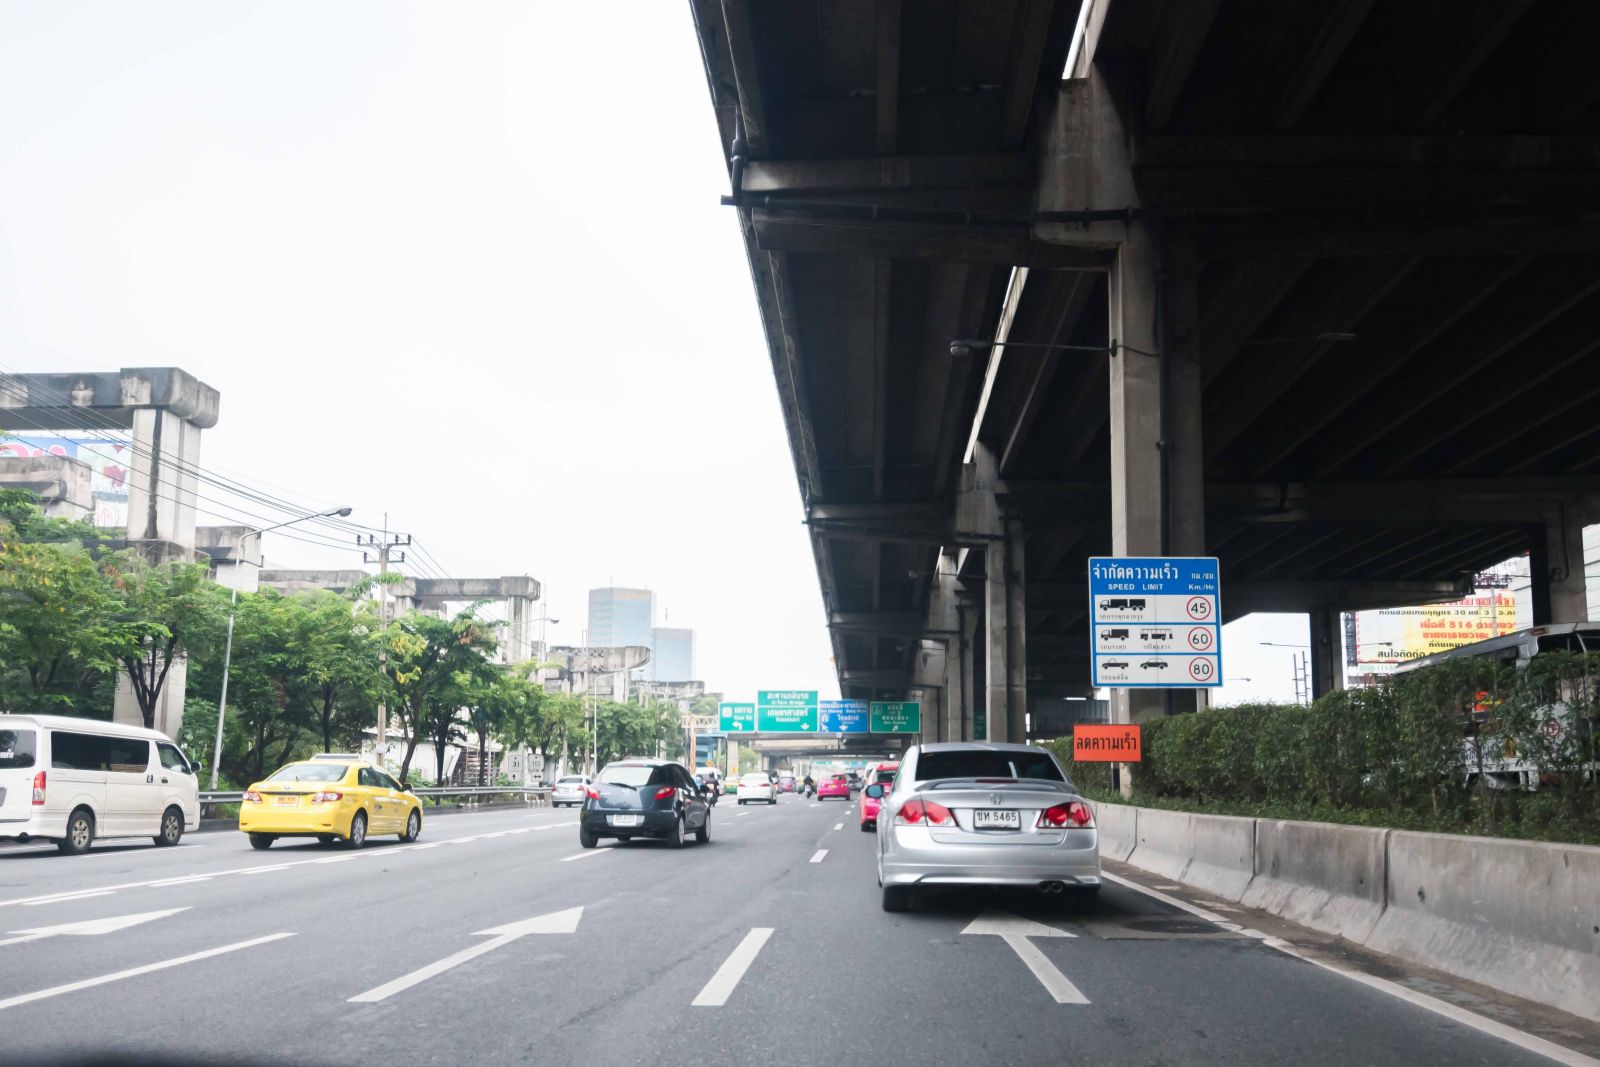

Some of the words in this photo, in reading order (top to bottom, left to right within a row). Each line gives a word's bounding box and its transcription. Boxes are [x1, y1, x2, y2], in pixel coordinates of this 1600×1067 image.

[1093, 562, 1179, 580] จำกัดความเร็ว
[1108, 583, 1135, 591] SPEED
[1142, 583, 1164, 591] LIMIT
[1190, 602, 1207, 614] 45
[1192, 633, 1209, 645] 60
[1193, 663, 1210, 675] 80
[1076, 732, 1137, 750] ลดความเร็ว
[993, 811, 1017, 821] 5465
